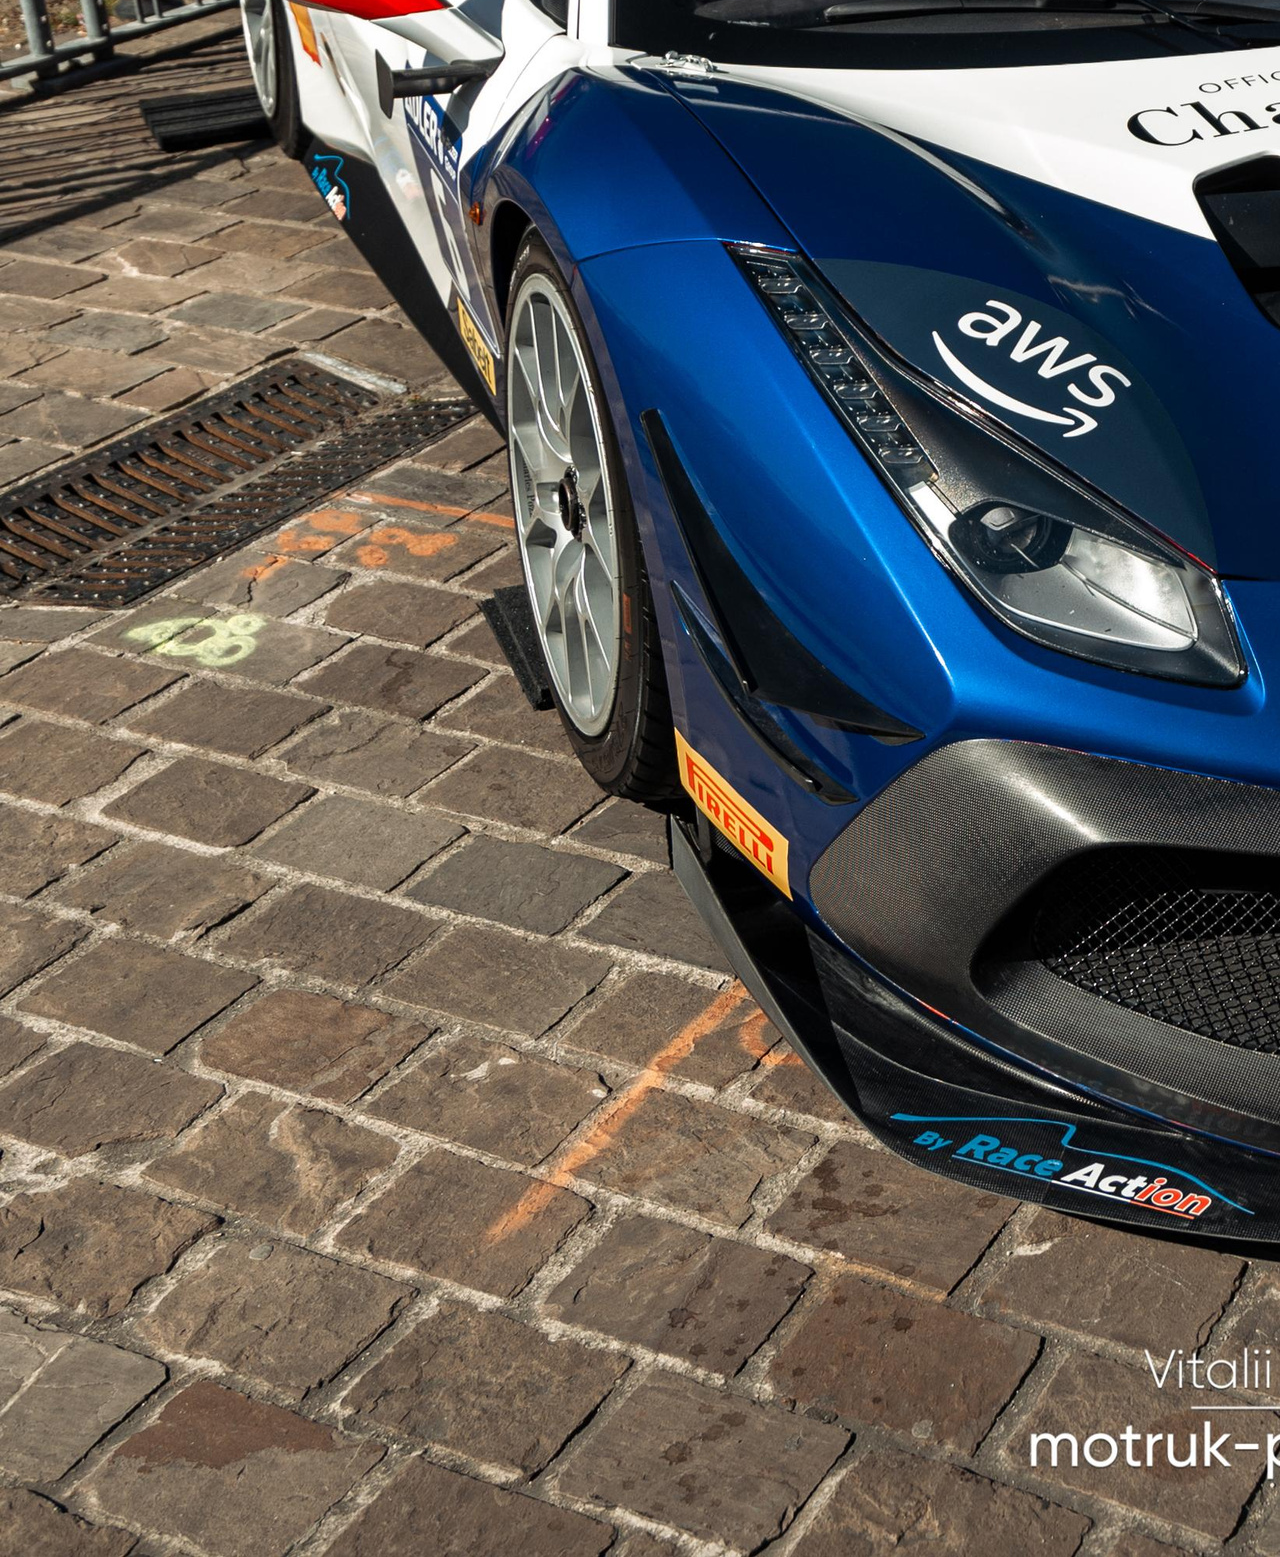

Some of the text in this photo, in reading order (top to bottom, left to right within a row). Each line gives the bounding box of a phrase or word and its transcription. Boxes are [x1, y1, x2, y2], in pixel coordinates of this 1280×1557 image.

[958, 299, 1132, 408] aws
[685, 752, 774, 875] PIRELLI
[912, 1131, 1212, 1217] By Race Action
